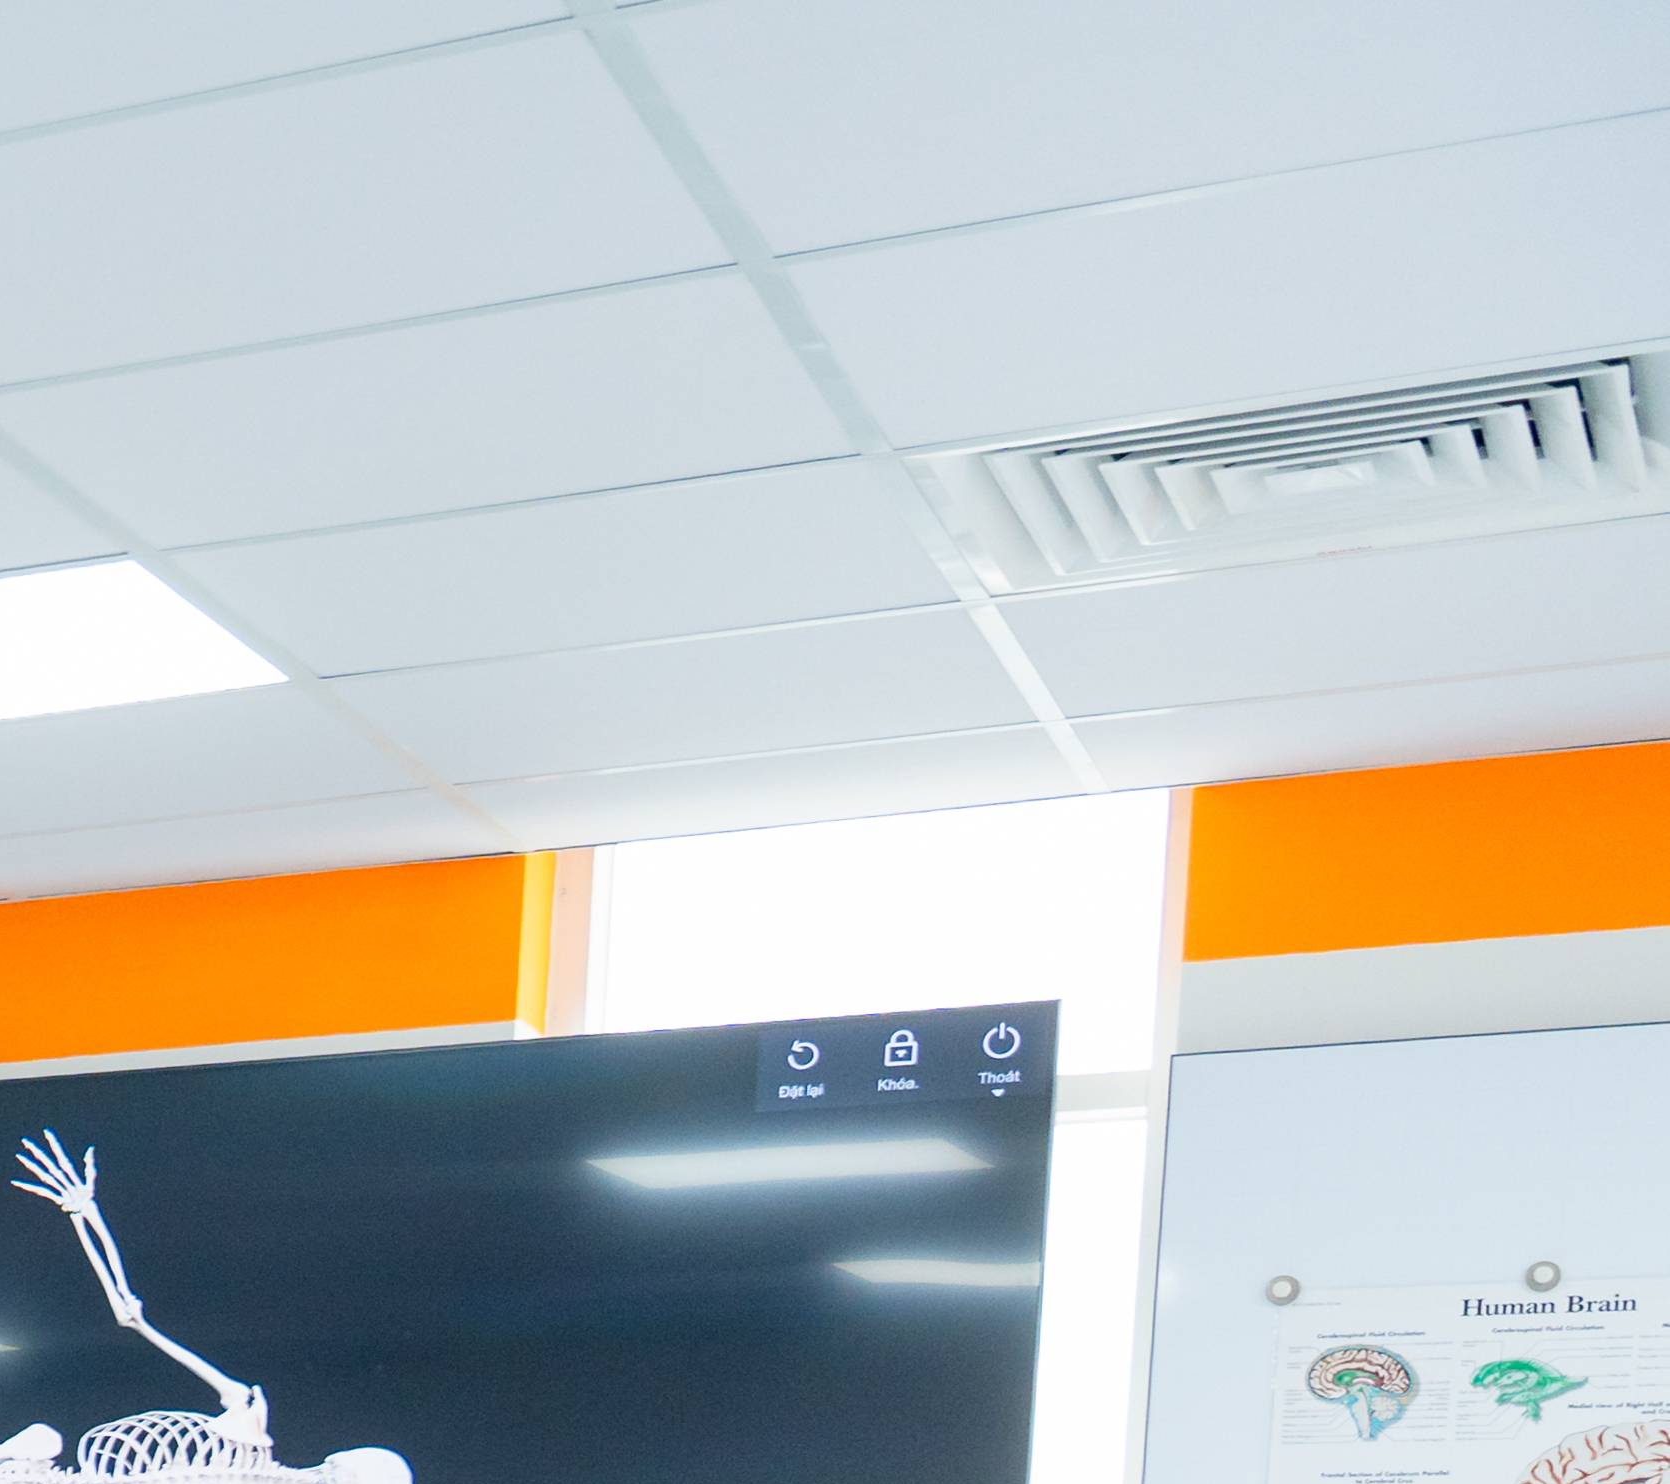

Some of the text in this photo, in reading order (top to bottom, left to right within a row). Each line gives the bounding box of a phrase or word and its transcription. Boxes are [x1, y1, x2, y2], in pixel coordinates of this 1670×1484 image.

[977, 1070, 1021, 1084] Thoát
[1461, 1293, 1638, 1317] Human Brain
